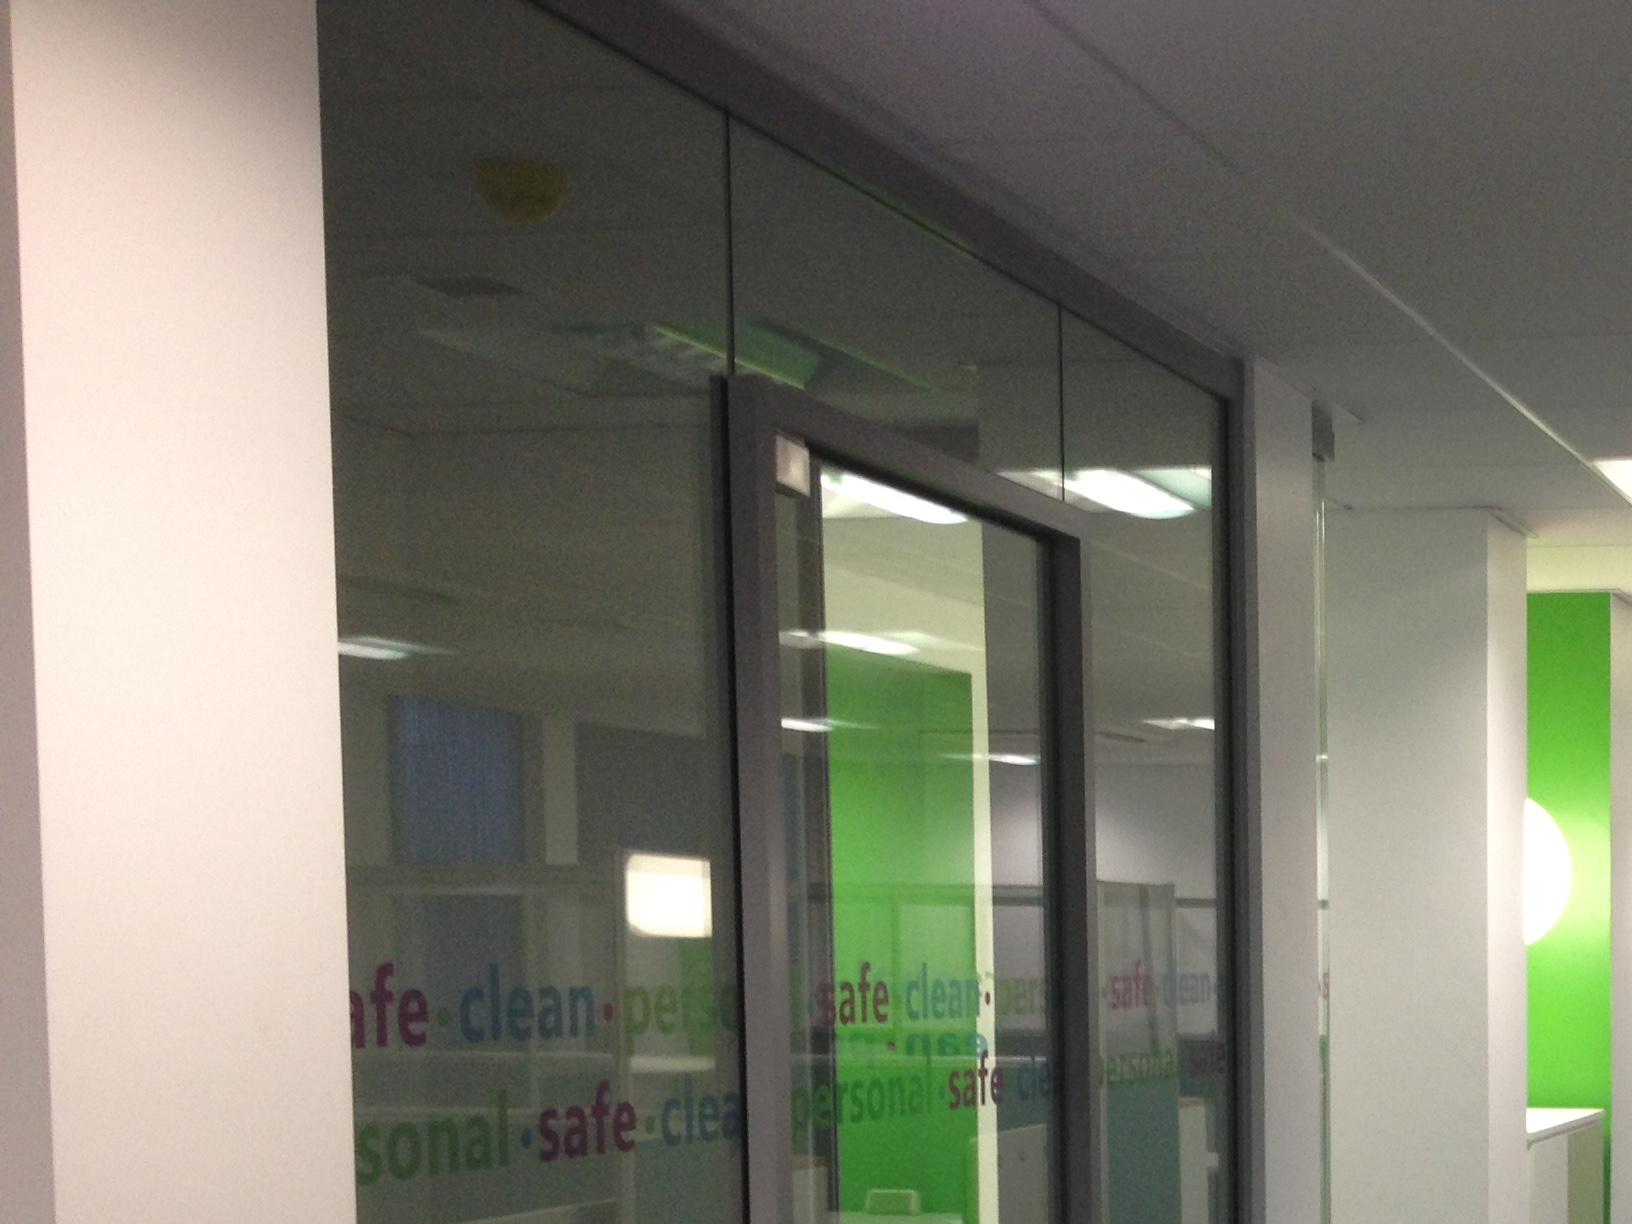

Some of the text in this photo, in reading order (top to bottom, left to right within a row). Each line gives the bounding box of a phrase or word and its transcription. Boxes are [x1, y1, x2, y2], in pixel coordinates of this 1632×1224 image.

[460, 963, 597, 1044] clean
[815, 960, 890, 1027] safe
[905, 962, 981, 1022] clean
[1110, 960, 1154, 1010] safe
[947, 1048, 1006, 1112] safe
[539, 1080, 637, 1162] safe
